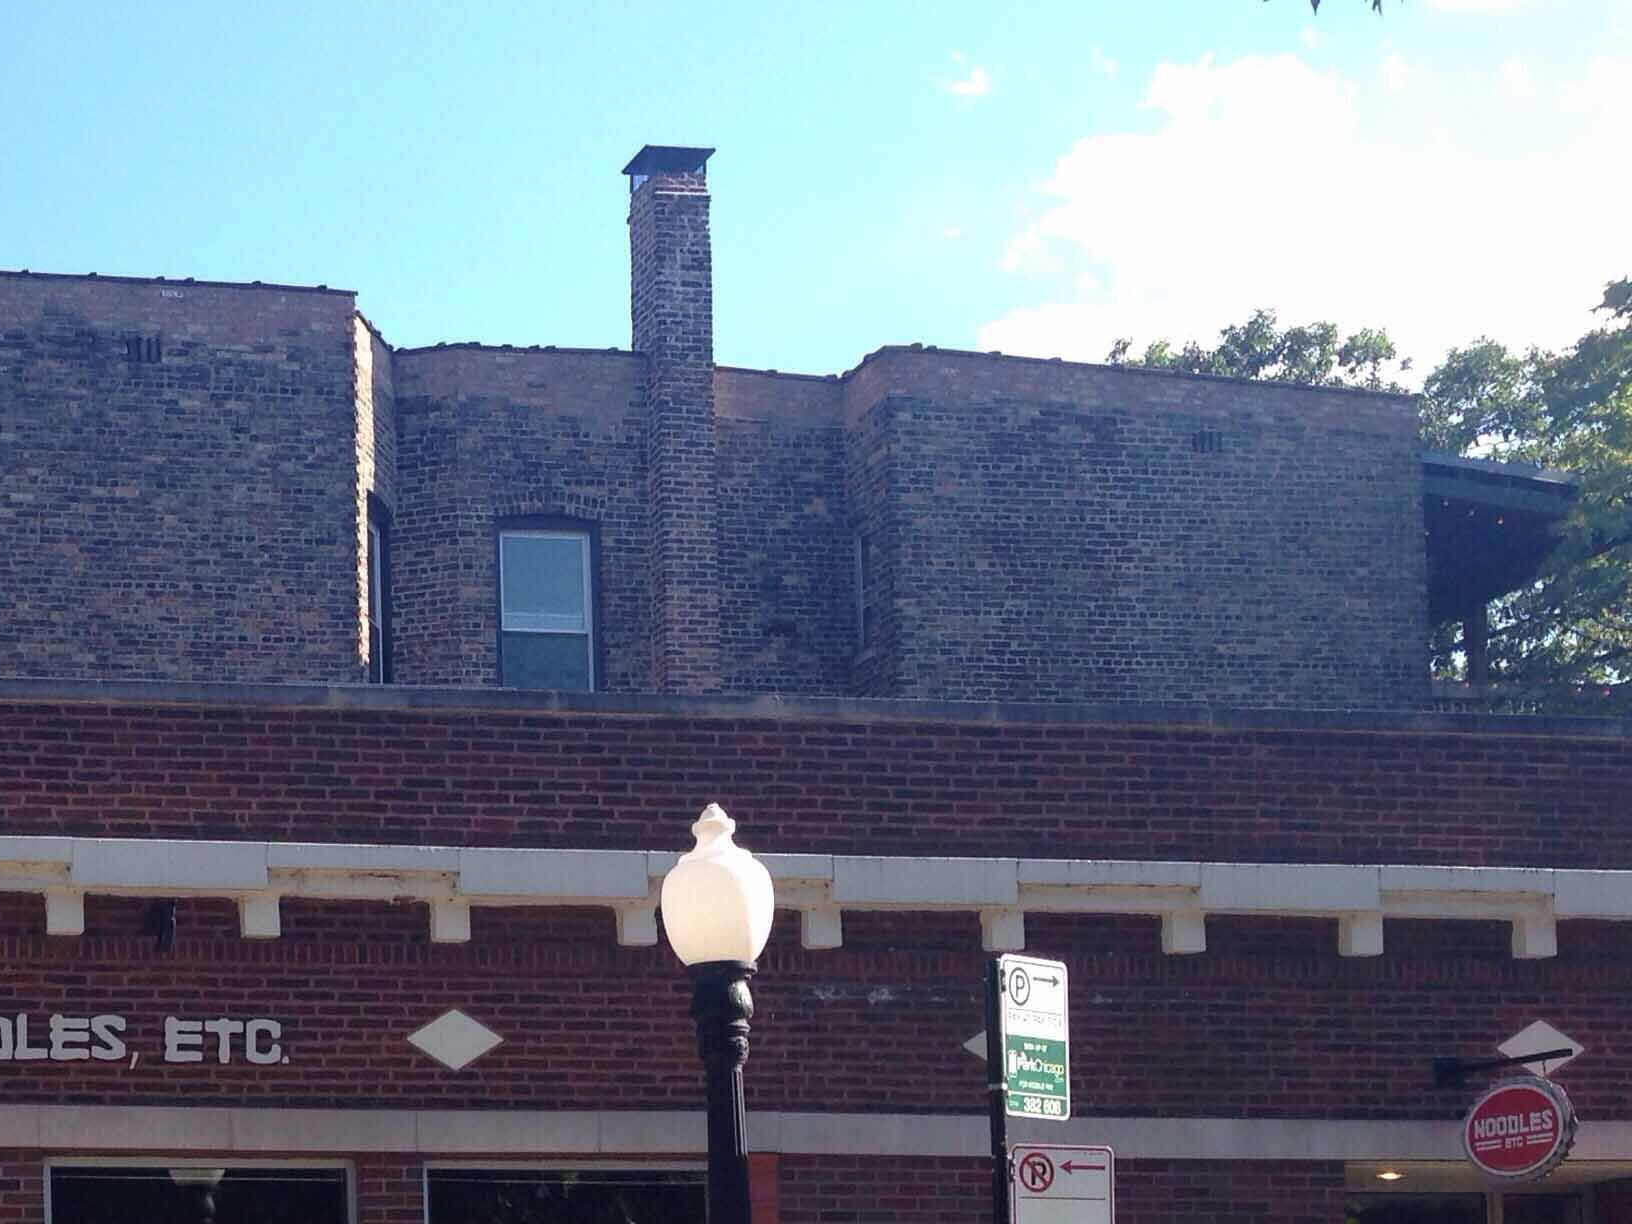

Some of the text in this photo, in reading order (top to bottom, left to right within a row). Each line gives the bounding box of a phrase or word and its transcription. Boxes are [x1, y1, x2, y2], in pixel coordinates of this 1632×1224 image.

[164, 1016, 289, 1064] ETC.
[1024, 1097, 1042, 1113] 382
[1474, 1109, 1553, 1139] NOODLES
[1504, 1136, 1524, 1149] ETC
